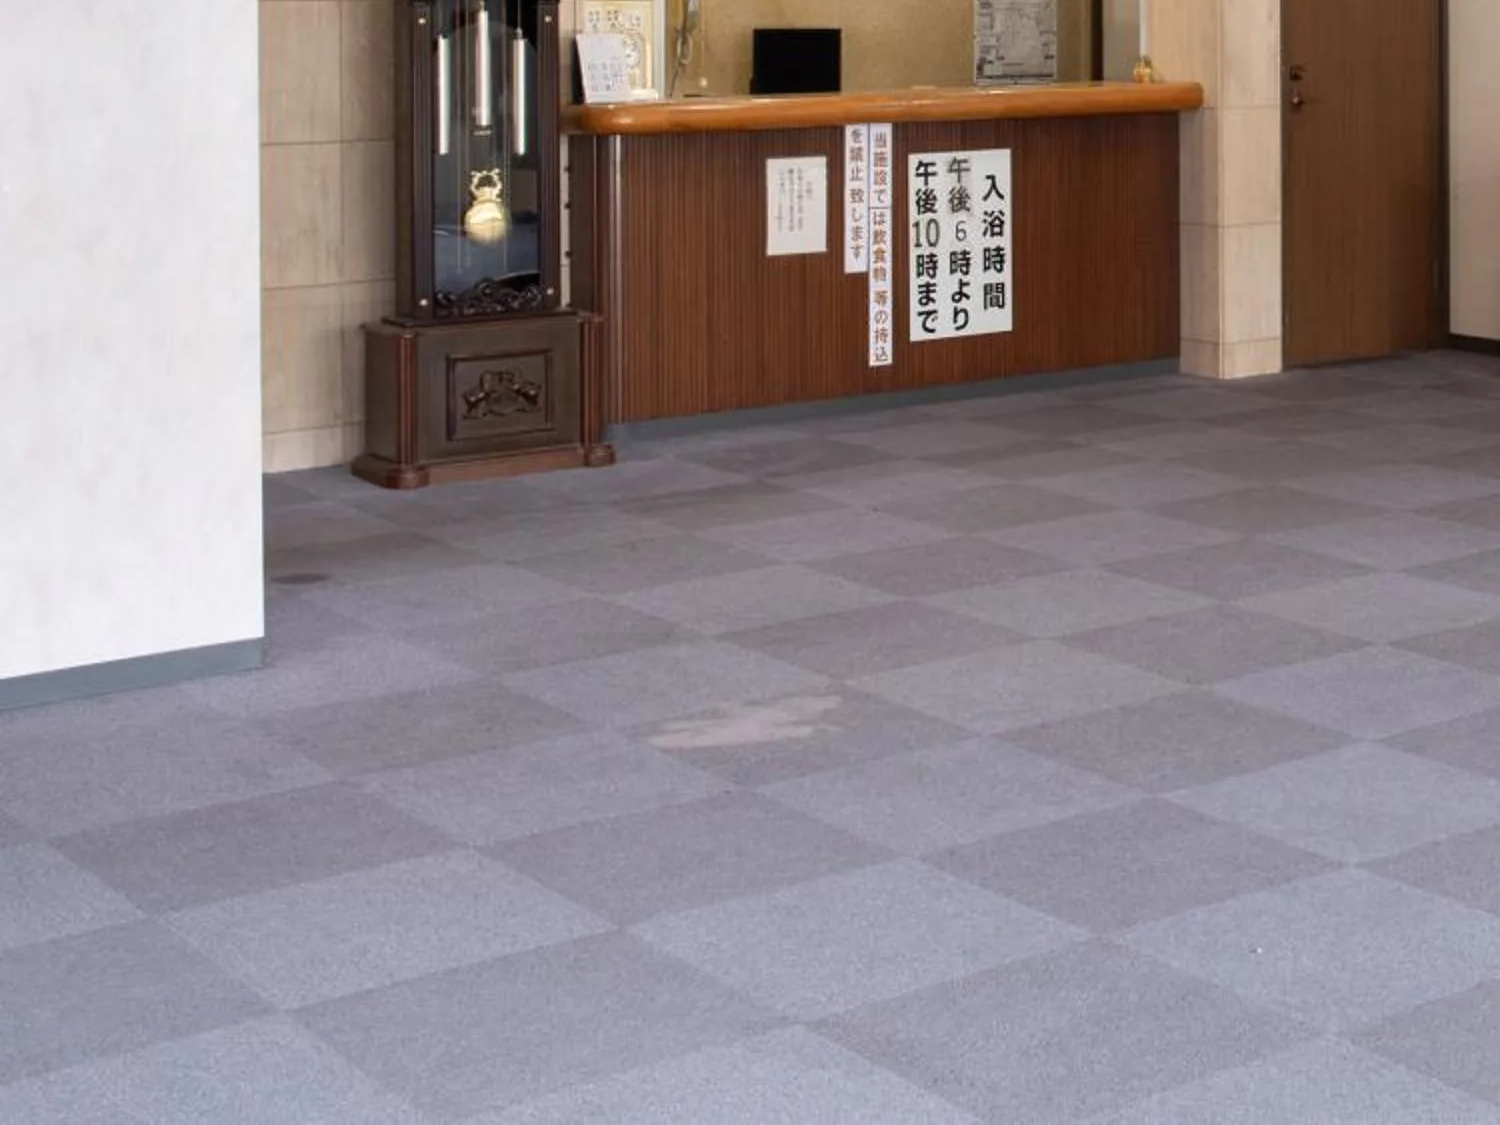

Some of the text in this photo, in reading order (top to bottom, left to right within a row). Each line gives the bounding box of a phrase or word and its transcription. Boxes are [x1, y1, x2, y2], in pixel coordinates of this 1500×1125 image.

[912, 159, 941, 335] 午後10時まで
[947, 156, 972, 332] 午後6時より
[982, 174, 1006, 311] 入浴時間
